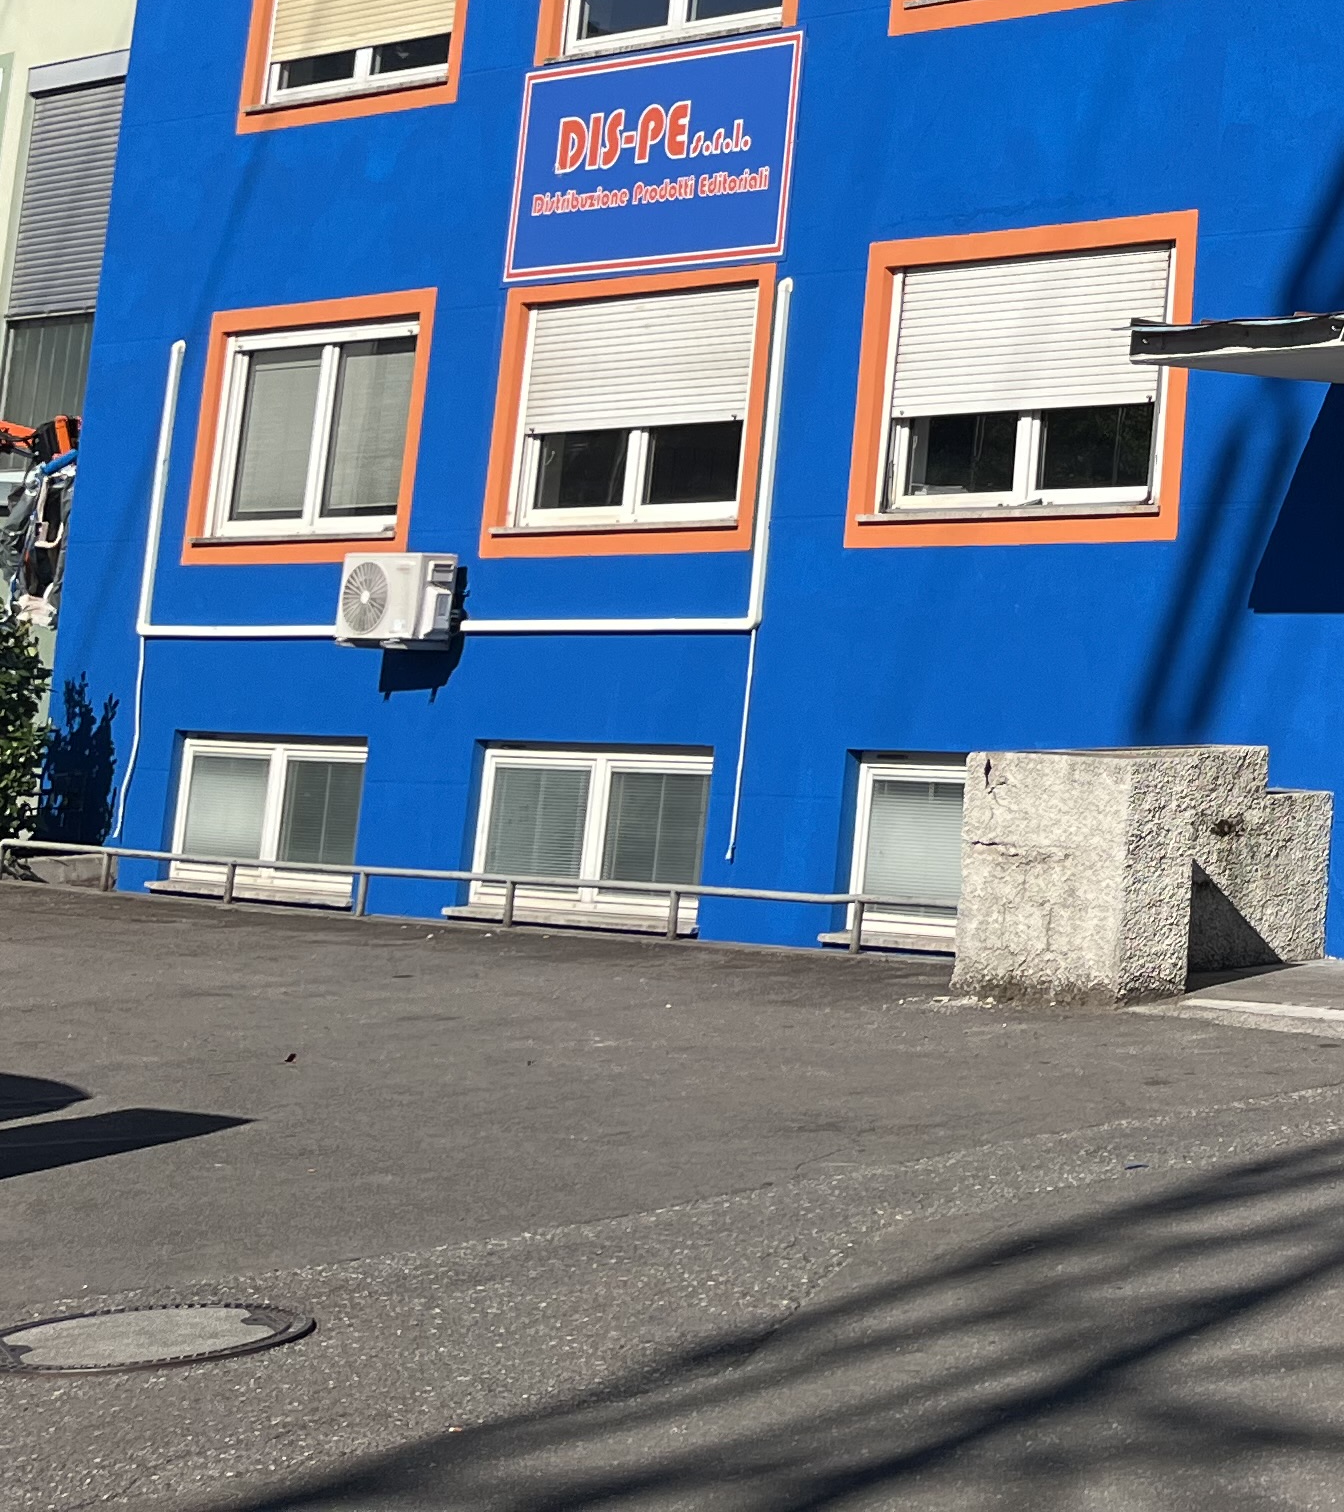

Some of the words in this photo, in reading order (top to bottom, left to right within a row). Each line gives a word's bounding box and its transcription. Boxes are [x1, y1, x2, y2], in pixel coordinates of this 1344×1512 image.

[555, 100, 692, 174] DIS-PE
[531, 186, 629, 216] Distribuzione
[632, 175, 695, 205] Prodotti
[698, 166, 770, 197] Editoriali
